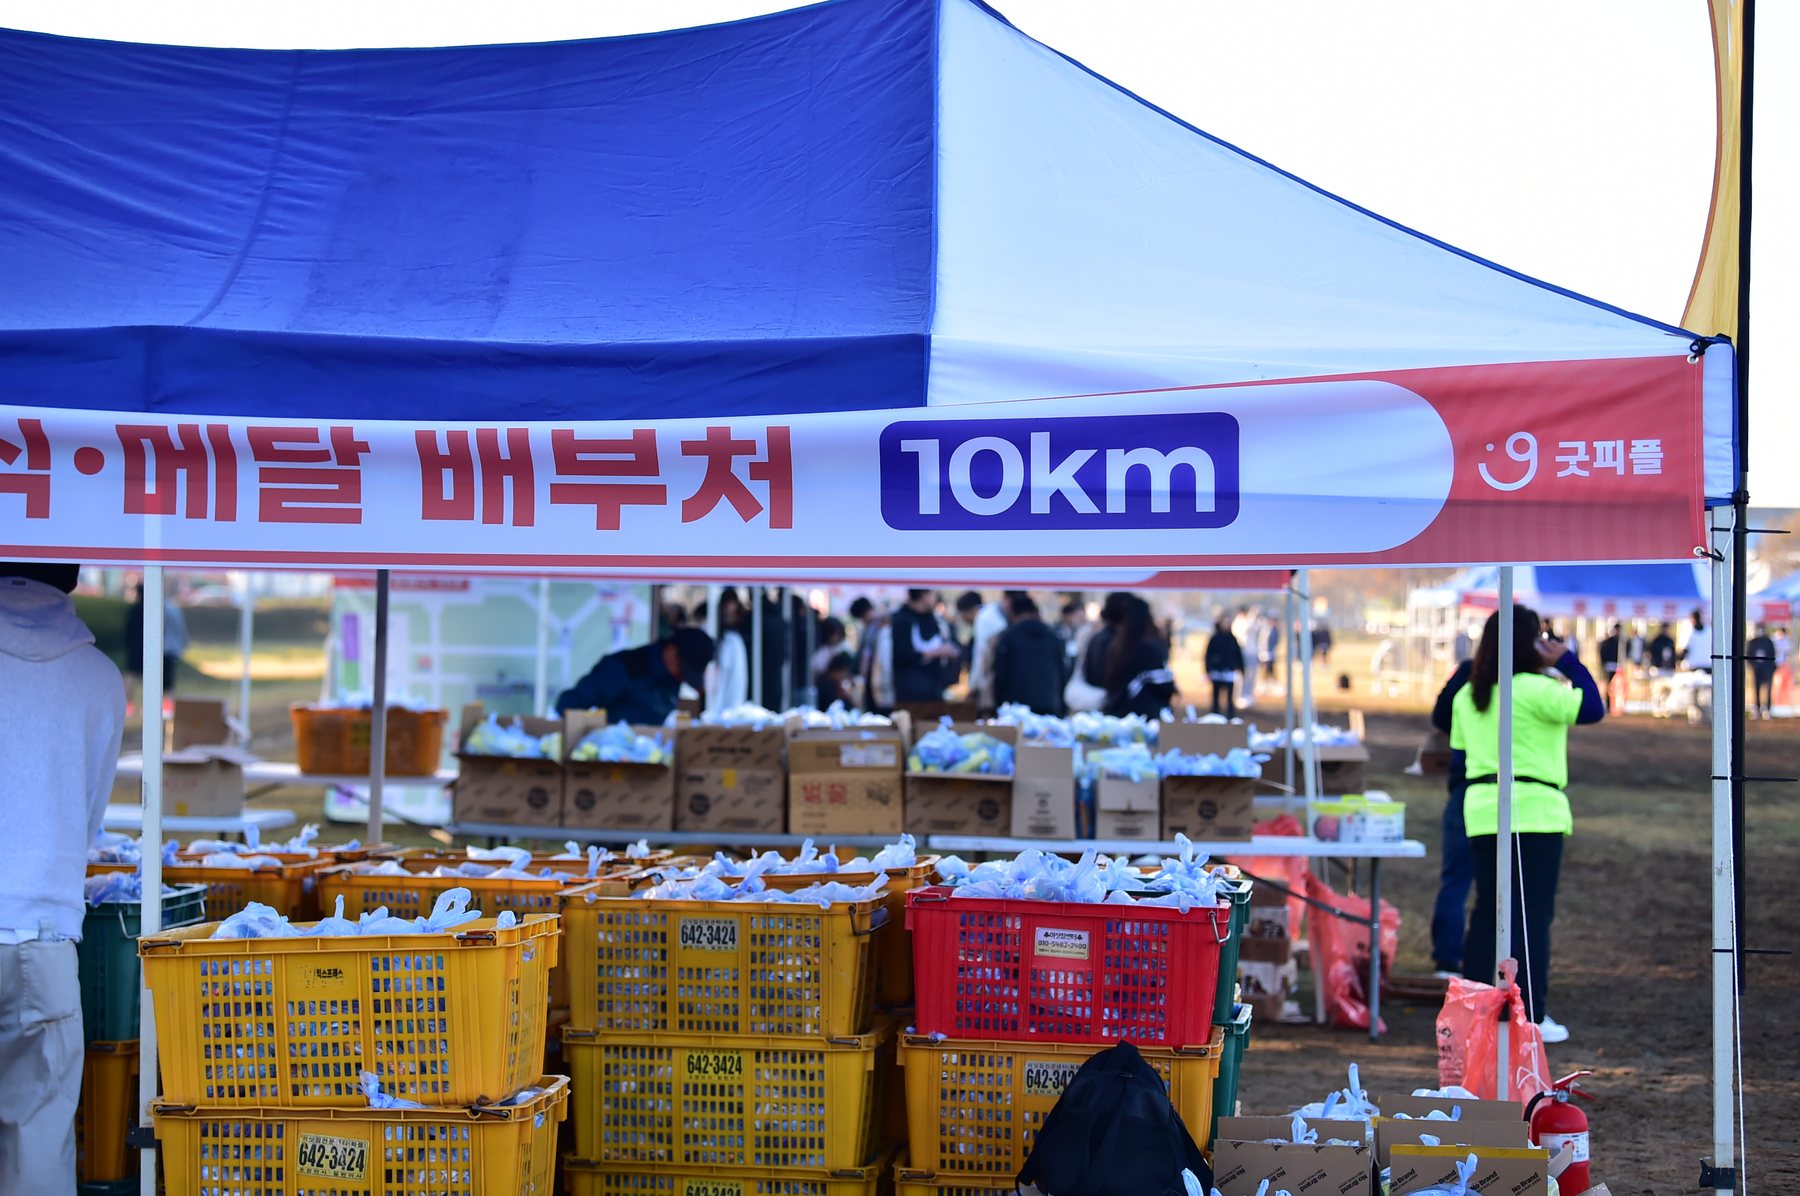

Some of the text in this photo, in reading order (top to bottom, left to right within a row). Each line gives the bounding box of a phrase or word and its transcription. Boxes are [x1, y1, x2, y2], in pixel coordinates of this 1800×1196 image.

[1555, 440, 1663, 477] 굿피플
[416, 427, 792, 530] 배부처
[901, 432, 1215, 515] 10km
[681, 925, 737, 945] 642-3424
[687, 1054, 743, 1075] 642-3424
[298, 1143, 366, 1173] 642-3424
[1218, 1172, 1238, 1188] Brand
[1299, 1176, 1320, 1192] Brand
[1397, 1168, 1416, 1184] Brand
[1437, 1169, 1457, 1185] Brand
[1478, 1171, 1498, 1186] Brand
[1520, 1172, 1539, 1188] Brand
[1340, 1178, 1360, 1194] Brand
